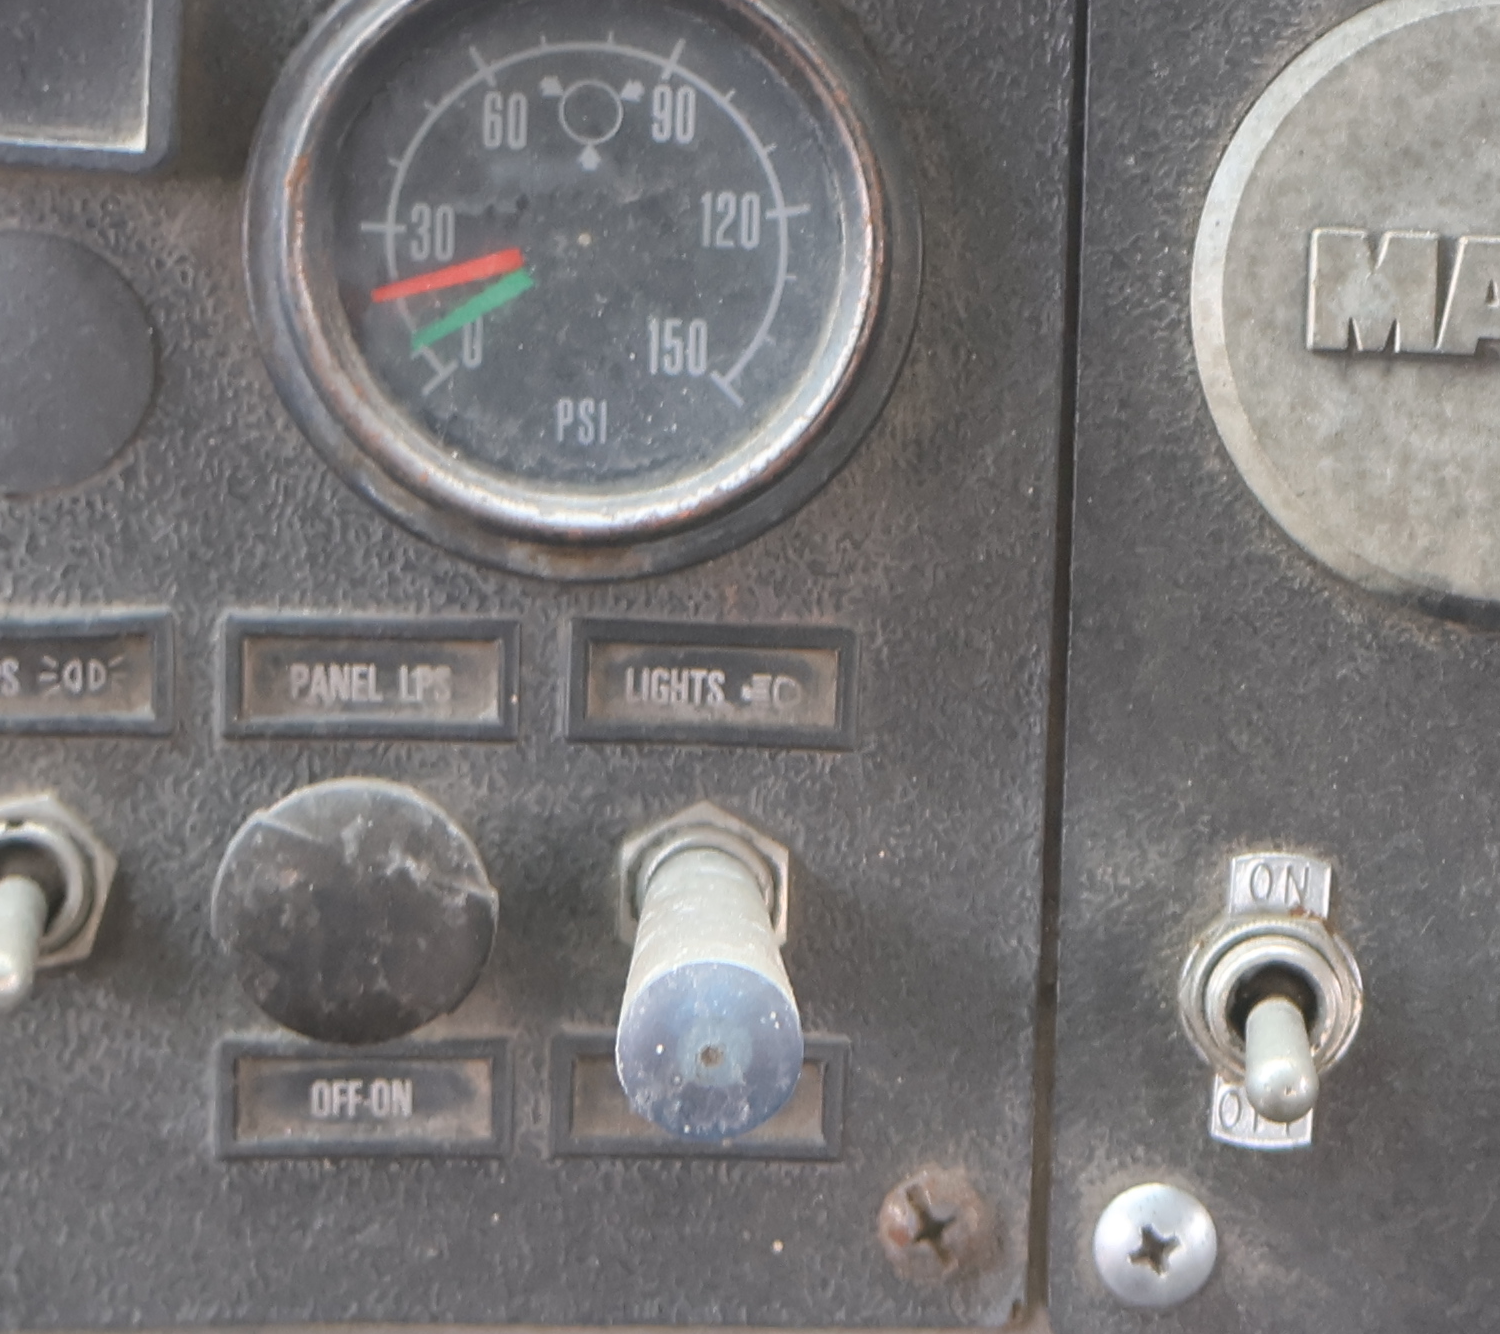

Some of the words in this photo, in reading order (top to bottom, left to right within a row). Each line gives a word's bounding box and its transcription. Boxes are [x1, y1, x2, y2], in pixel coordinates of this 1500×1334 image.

[482, 91, 528, 150] 60
[650, 85, 697, 144] 90
[409, 203, 456, 262] 30
[700, 191, 762, 250] 120
[460, 317, 484, 369] 0
[647, 318, 709, 375] 150
[556, 398, 608, 445] PSI
[289, 662, 383, 703] PANEL
[624, 666, 726, 705] LIGHTS
[1249, 863, 1311, 905] ON
